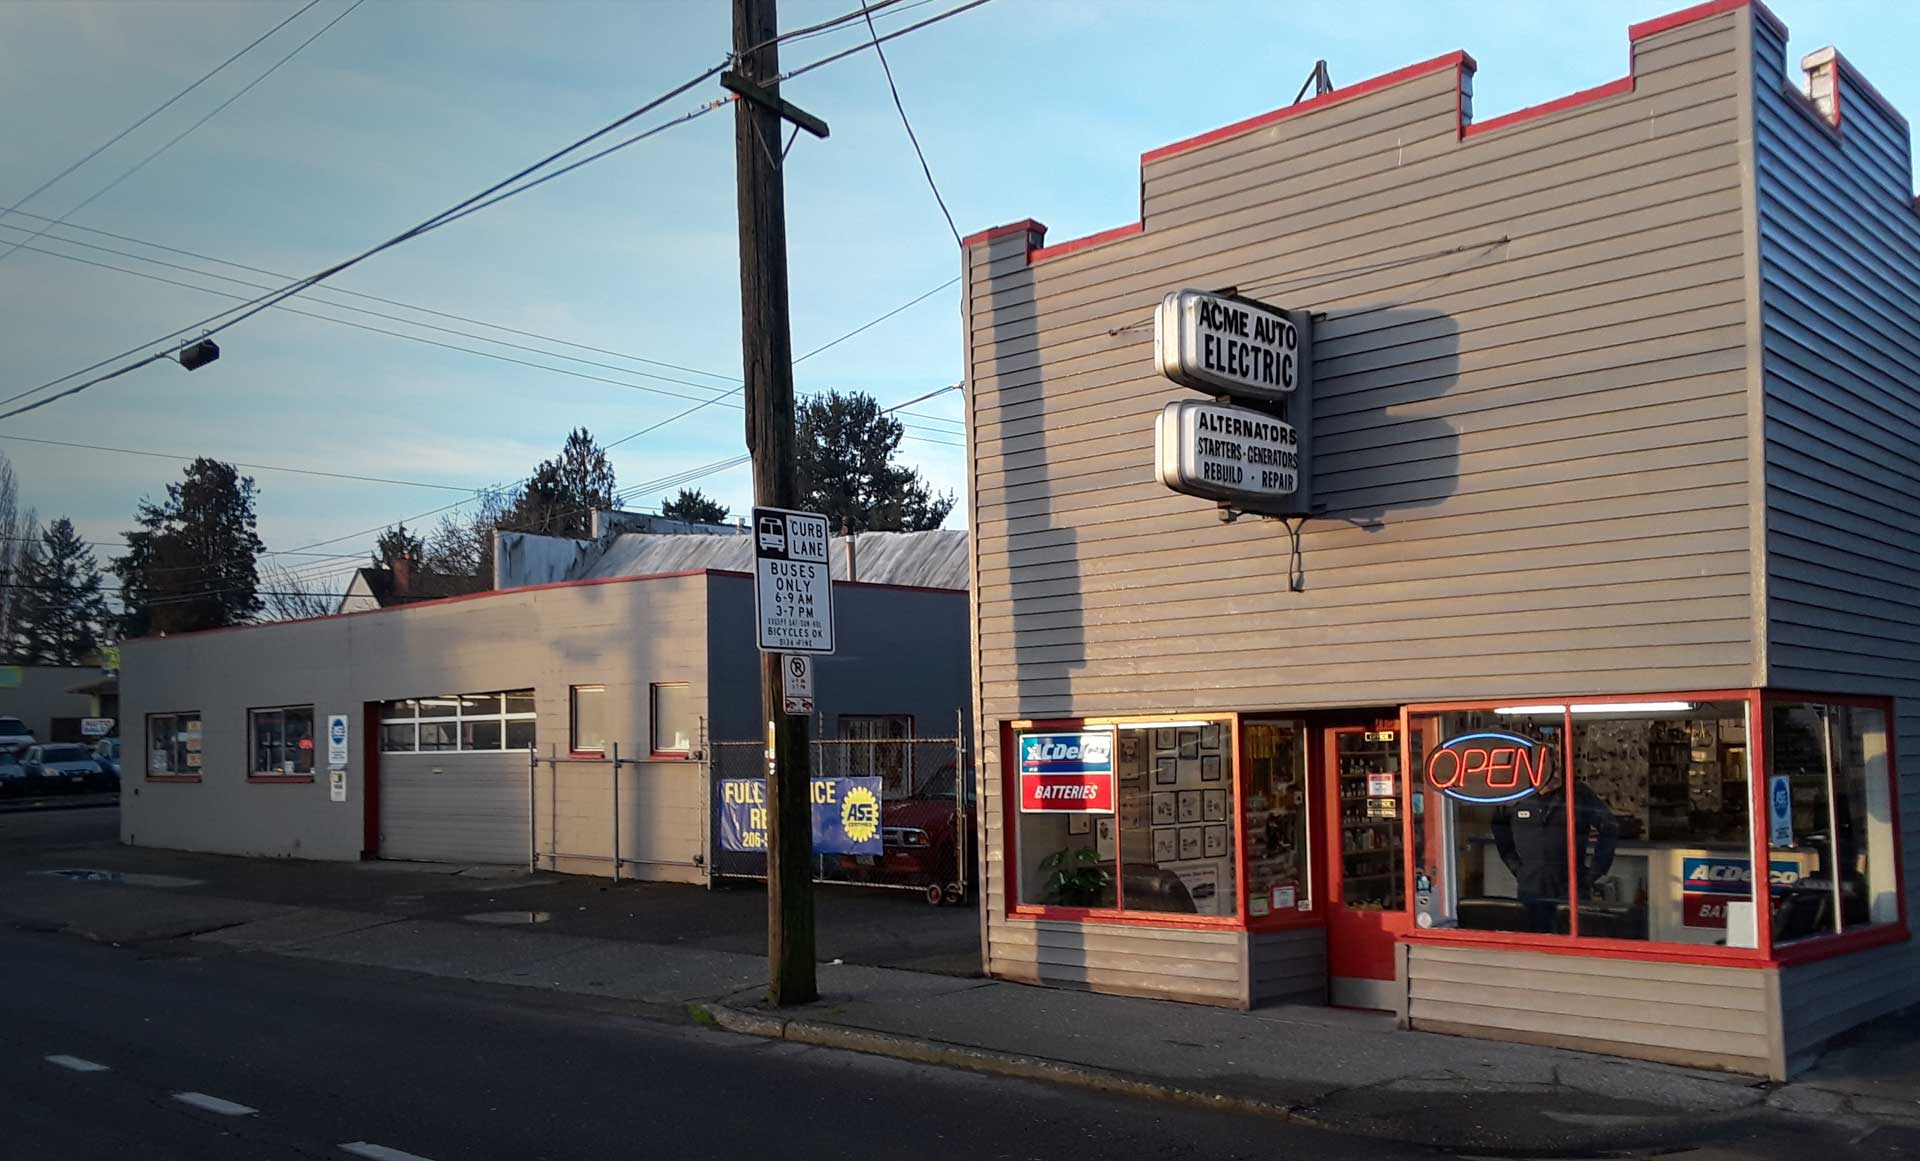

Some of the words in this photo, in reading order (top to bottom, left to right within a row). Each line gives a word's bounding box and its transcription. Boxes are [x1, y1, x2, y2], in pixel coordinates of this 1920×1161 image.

[1199, 299, 1249, 338] ACME
[1254, 316, 1298, 350] AUTO
[1204, 333, 1293, 389] ELECTRIC
[1199, 412, 1297, 445] ALTERNATORS
[1204, 461, 1243, 484] REBUILD
[1262, 471, 1293, 490] REPAIR
[791, 520, 823, 538] CURB
[793, 542, 824, 557] LANE
[771, 562, 816, 579] BUSES
[776, 578, 812, 593] ONLY
[775, 591, 795, 604] 6-9
[798, 594, 814, 606] AM
[776, 605, 794, 618] 3-7
[799, 606, 814, 619] PM
[768, 626, 809, 638] BICYCLES
[812, 629, 824, 639] OK
[1026, 743, 1110, 761] ACDel
[1429, 747, 1546, 788] OPEN
[724, 782, 764, 804] FULL
[810, 781, 836, 804] ICE
[1034, 784, 1098, 800] BATTERIES
[847, 803, 873, 821] ASE
